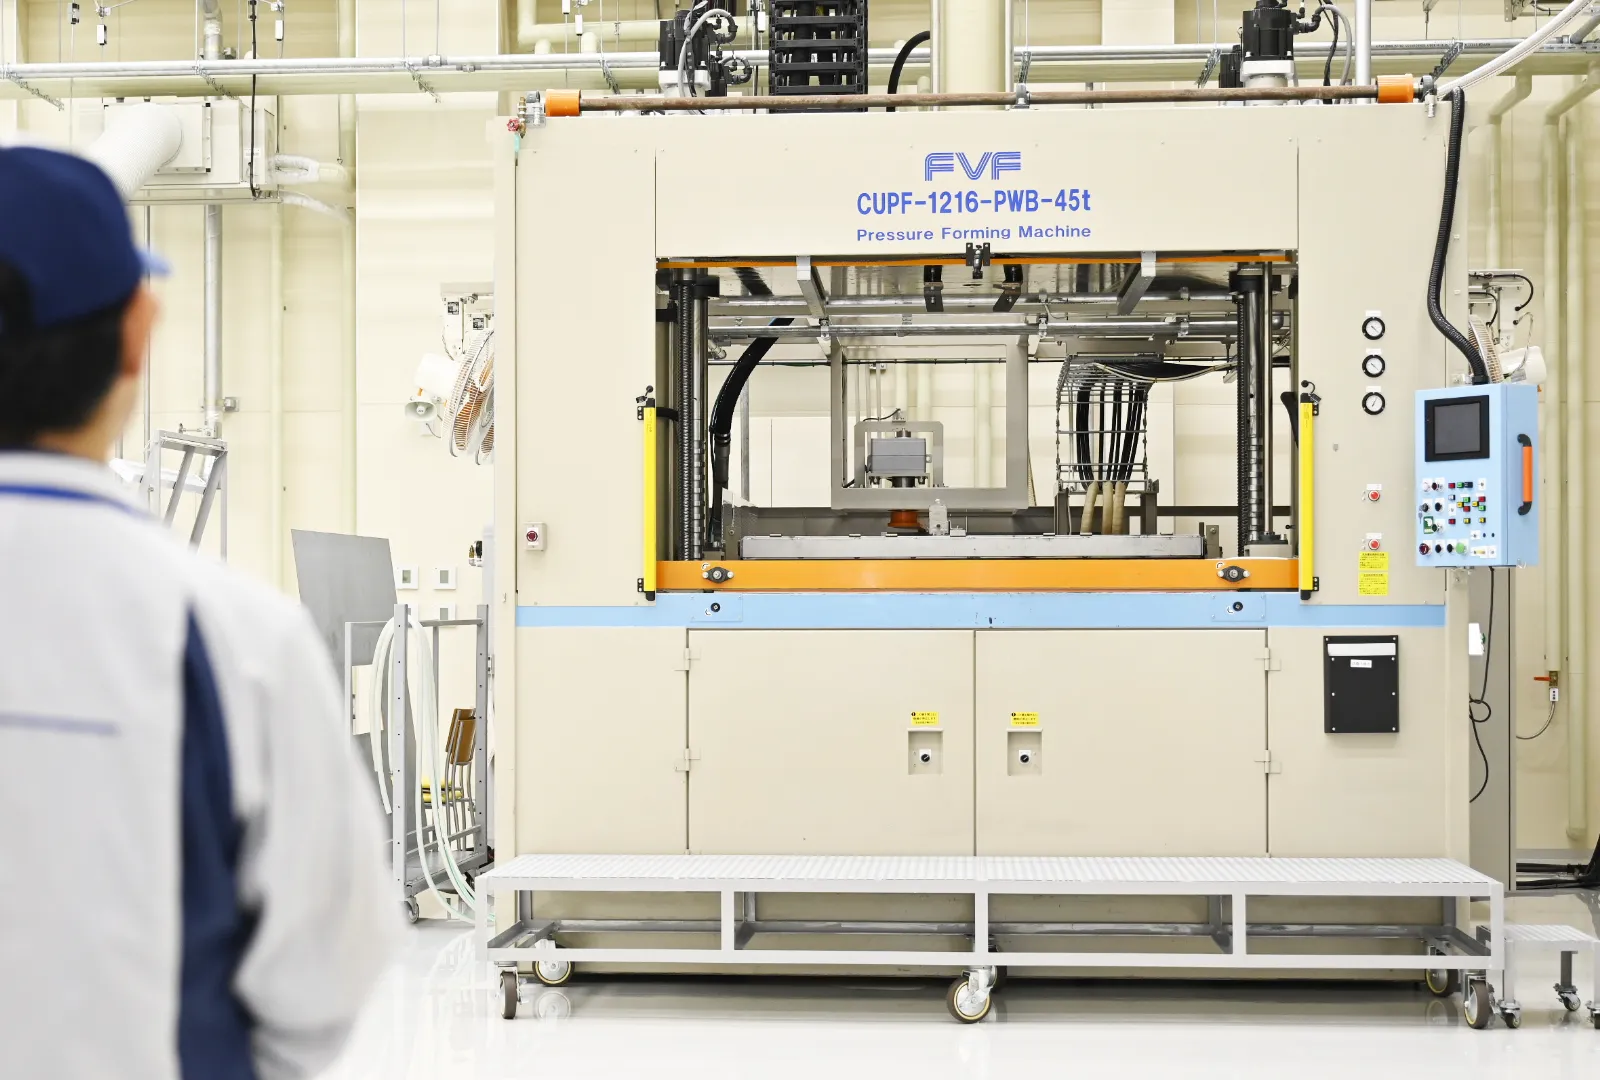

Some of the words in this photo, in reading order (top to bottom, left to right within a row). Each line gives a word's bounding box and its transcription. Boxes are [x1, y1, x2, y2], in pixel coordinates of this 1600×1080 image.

[924, 151, 1022, 181] FVF
[857, 188, 1092, 215] CUPF-1216-PWB-45t
[857, 229, 934, 241] Pressure
[941, 227, 1011, 240] Forming
[1018, 225, 1092, 239] Machine
